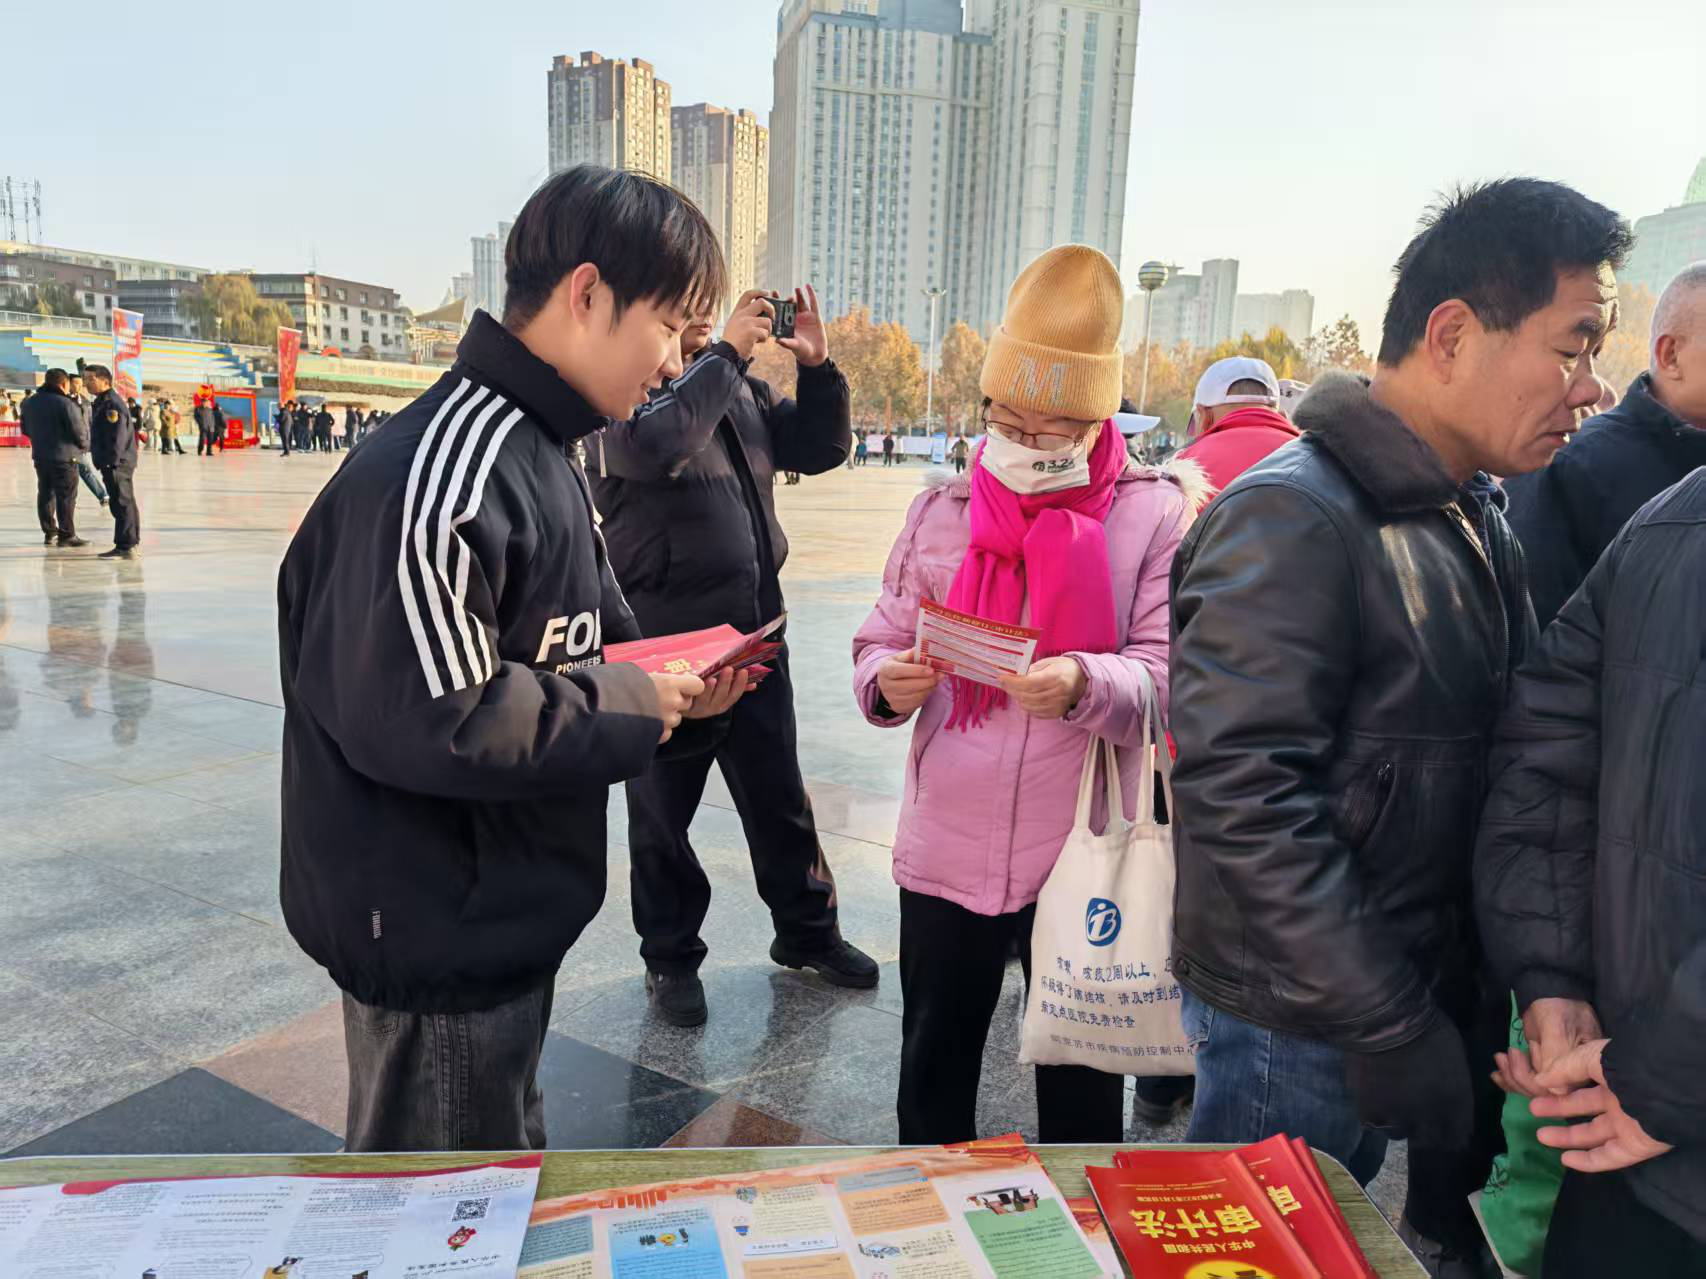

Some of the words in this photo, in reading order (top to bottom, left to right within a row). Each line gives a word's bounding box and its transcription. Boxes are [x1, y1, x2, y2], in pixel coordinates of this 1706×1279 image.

[1128, 1204, 1263, 1239] 审计法
[1162, 1240, 1256, 1254] 中华人民共和国
